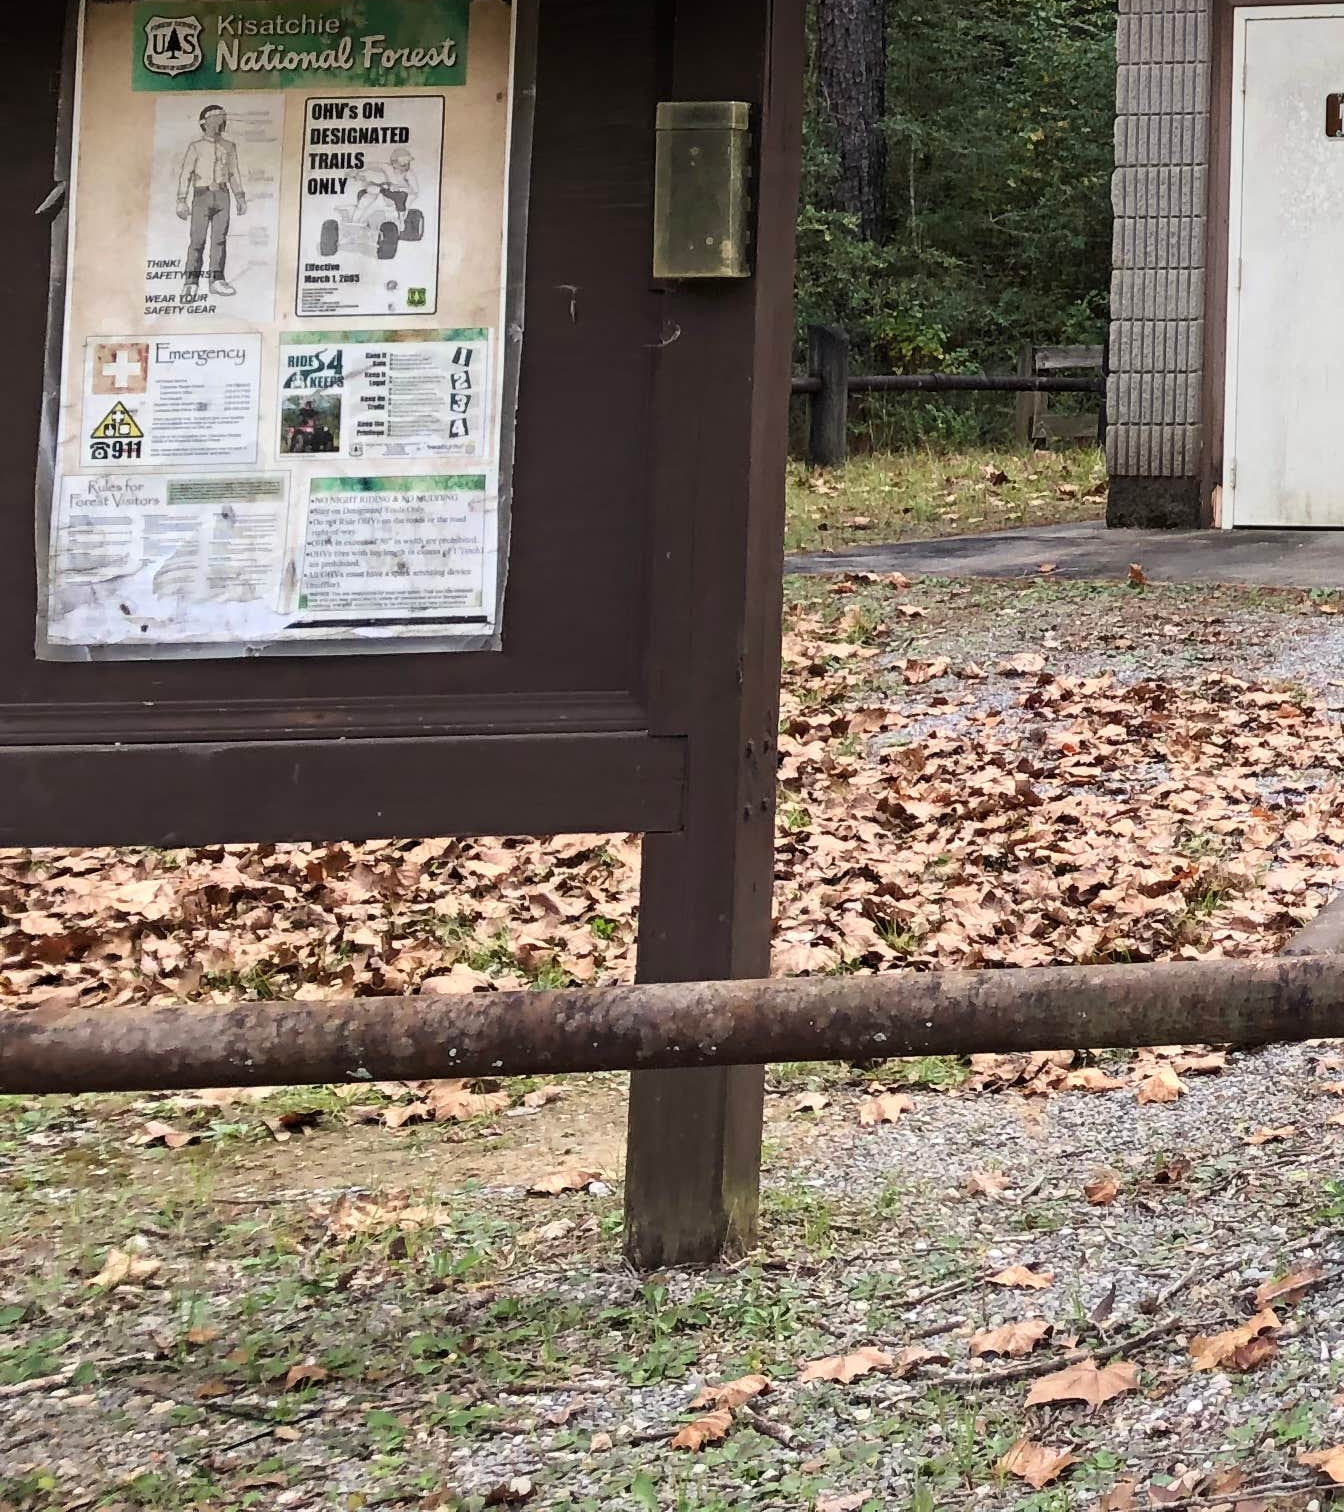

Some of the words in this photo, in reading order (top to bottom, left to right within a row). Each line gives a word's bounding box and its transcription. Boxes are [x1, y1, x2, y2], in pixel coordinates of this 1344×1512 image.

[217, 14, 341, 35] Kisatchie
[215, 36, 354, 73] National
[359, 34, 457, 68] Forest
[311, 102, 359, 120] OHV's
[362, 102, 385, 119] ON
[310, 126, 410, 145] DESIGNATED
[309, 152, 365, 170] TRAILS
[307, 177, 348, 195] ONLY
[147, 259, 182, 268] THINK!
[305, 263, 340, 272] Effective
[145, 271, 187, 280] SAFETY
[304, 274, 330, 284] March
[145, 294, 176, 303] WEAR
[179, 293, 209, 303] YOUR
[144, 306, 185, 315] SAFETY
[187, 304, 217, 314] GEAR
[154, 341, 247, 367] Emergency
[310, 375, 345, 389] KEEPS
[111, 439, 142, 460] 911
[88, 478, 123, 494] Rules
[125, 478, 145, 493] for
[69, 493, 110, 508] Forest
[111, 493, 160, 508] Visitors
